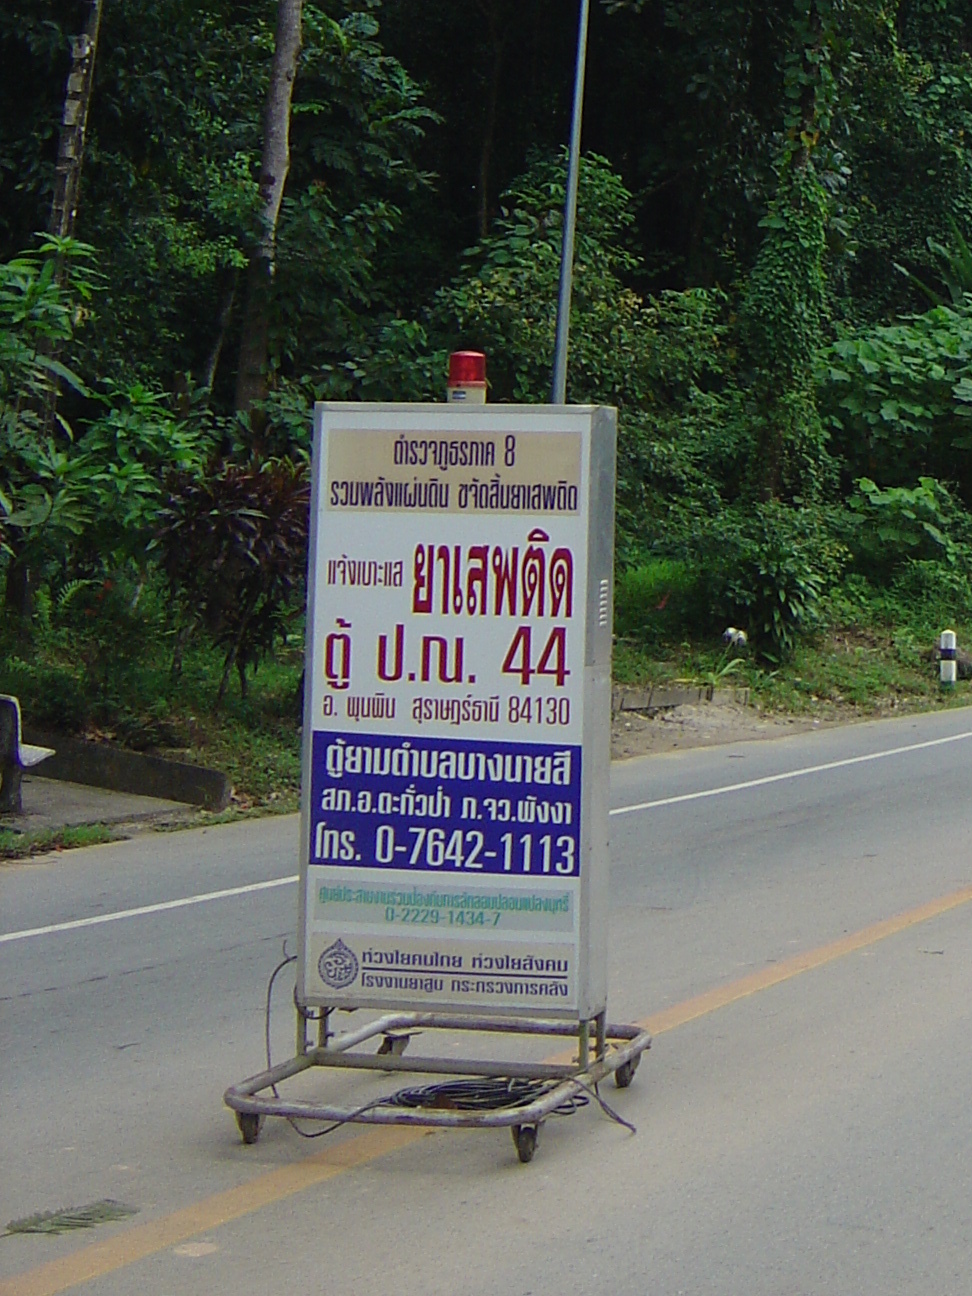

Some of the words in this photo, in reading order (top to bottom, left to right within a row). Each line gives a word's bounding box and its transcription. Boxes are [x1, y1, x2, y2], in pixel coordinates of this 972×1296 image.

[394, 434, 495, 470] ตำรวจภูธรภาค
[504, 434, 516, 467] 8
[330, 476, 449, 509] รวมพลังแผ่นดิน
[458, 473, 578, 511] ขจัดสิ้นยาเสพติด
[327, 554, 404, 588] แจ้งเบาะแส
[412, 528, 574, 618] ยาเสพติด
[324, 618, 352, 690] ตู้
[377, 623, 476, 684] ป.ณ.
[501, 625, 571, 687] 44
[322, 694, 338, 717] อ.
[346, 692, 396, 722] พุนพิน
[412, 694, 500, 726] สุราษฎร์ธานี
[508, 695, 571, 725] 84130
[326, 738, 572, 786] ตู้ยามตำบลบางนายสี
[321, 784, 451, 818] สภ.อ.ตะกั่วป่า
[461, 795, 573, 825] ภ.จว.พังงา
[314, 821, 361, 861] โทร.
[374, 824, 575, 874] 0-7642-1113
[385, 909, 502, 927] 0-2229-1434-7
[360, 972, 444, 994] โรงงานยาสูบ
[450, 979, 569, 997] กระทรวงการคลัง
